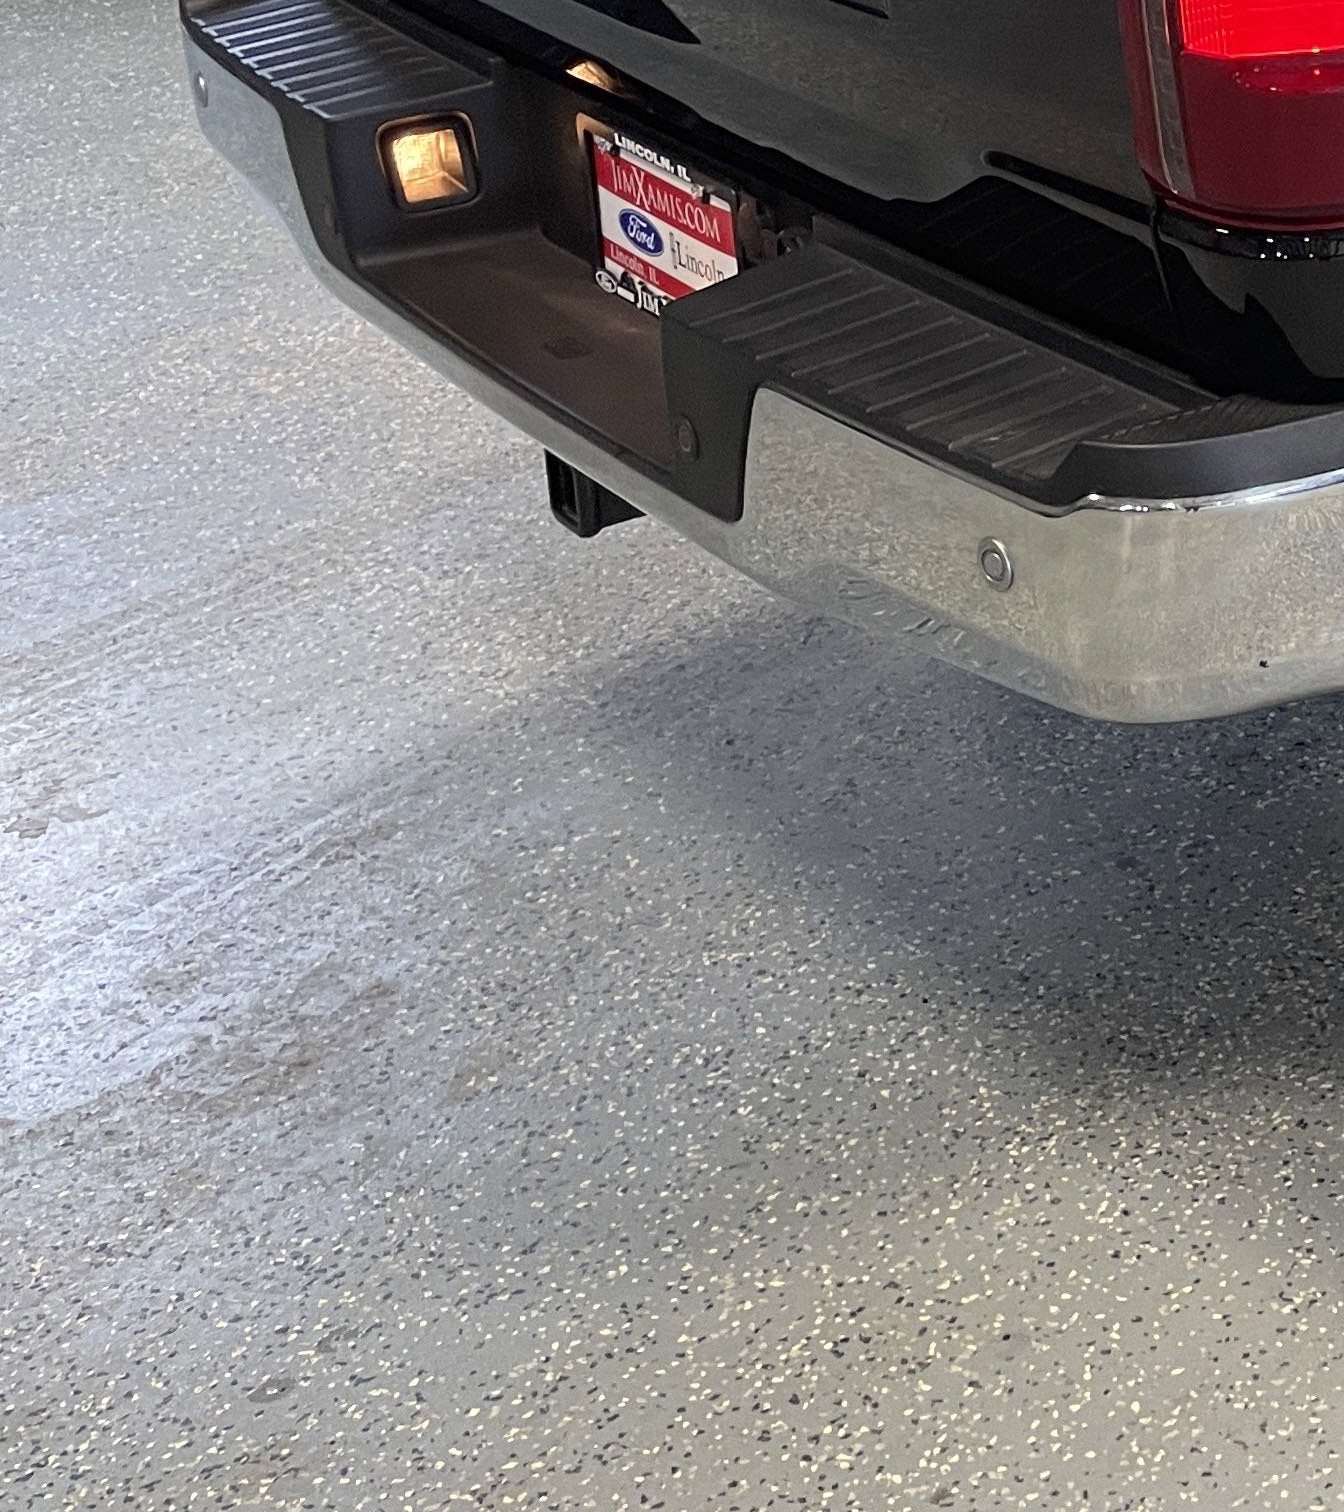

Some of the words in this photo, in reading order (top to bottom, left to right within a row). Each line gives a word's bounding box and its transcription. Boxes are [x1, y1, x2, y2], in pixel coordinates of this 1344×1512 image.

[614, 133, 675, 174] LINCOLN,
[677, 163, 692, 182] IL
[611, 159, 721, 242] JIMXAMIS.COM
[627, 214, 656, 251] Ford
[649, 271, 660, 286] IL
[676, 241, 725, 283] Lincoln
